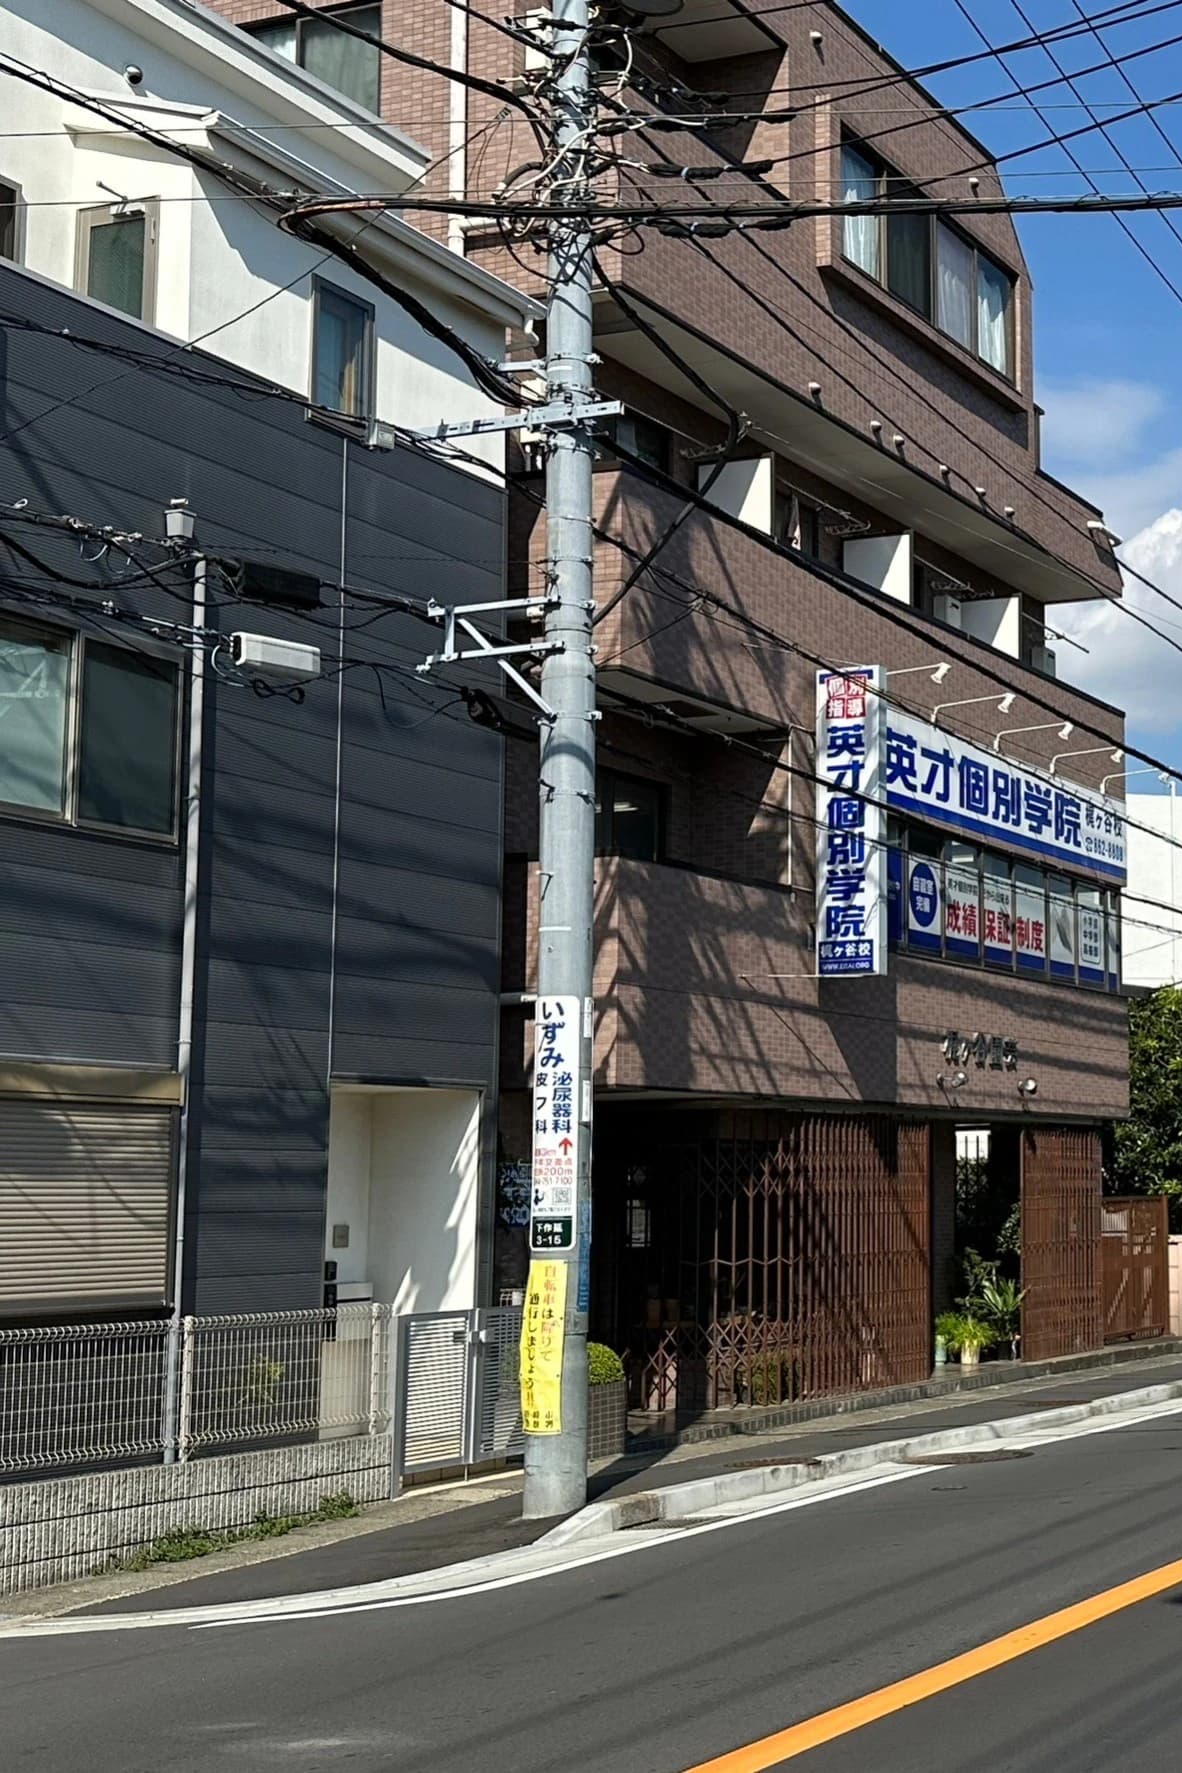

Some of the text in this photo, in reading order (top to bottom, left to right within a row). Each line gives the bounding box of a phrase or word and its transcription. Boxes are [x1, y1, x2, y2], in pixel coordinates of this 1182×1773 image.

[887, 726, 1082, 848] 英才個別学院
[826, 724, 866, 938] 英才個別学院
[541, 1001, 566, 1068] いずみ
[536, 1072, 549, 1135] 皮フ科
[552, 1071, 573, 1134] 泌尿器科
